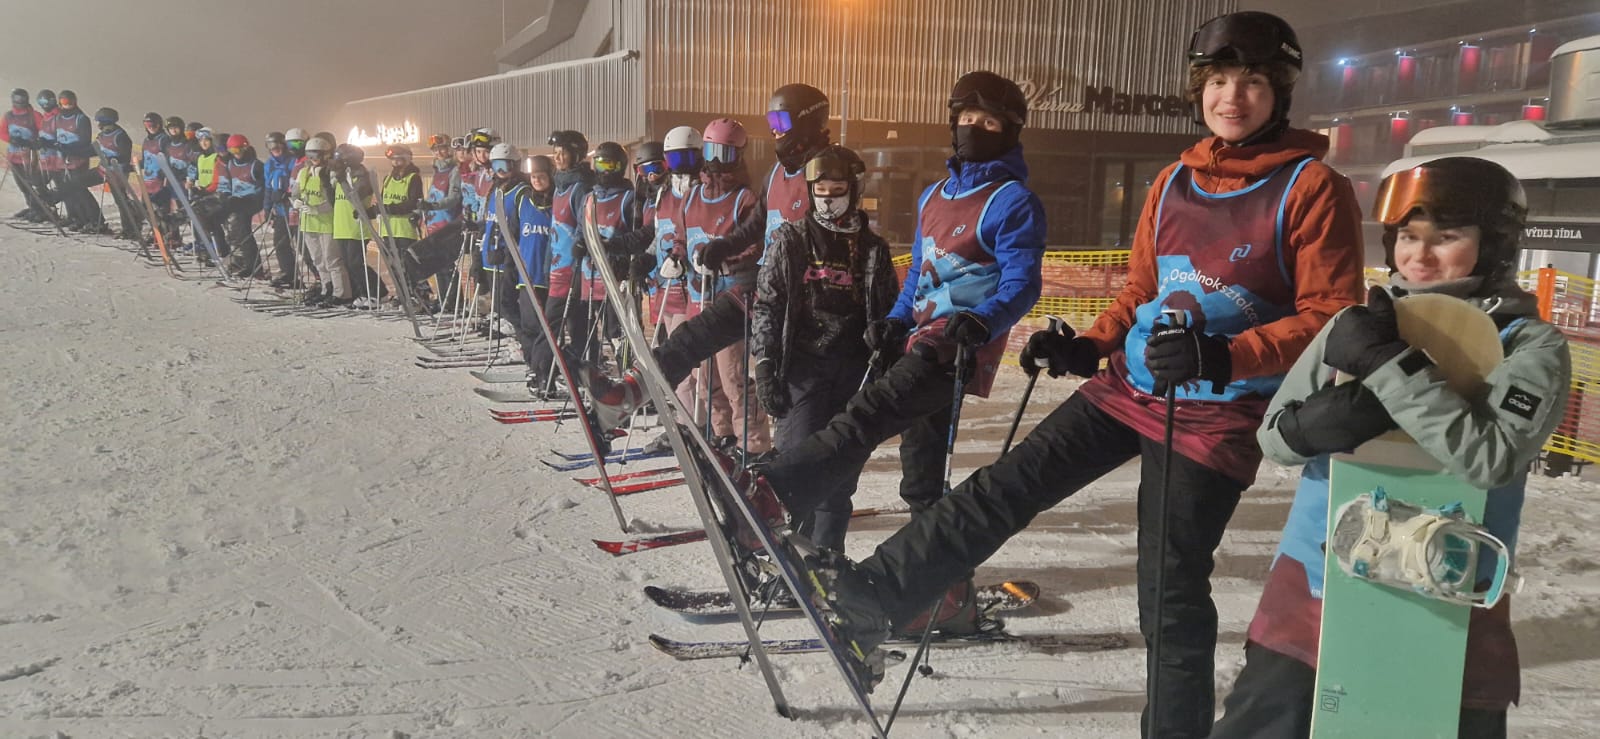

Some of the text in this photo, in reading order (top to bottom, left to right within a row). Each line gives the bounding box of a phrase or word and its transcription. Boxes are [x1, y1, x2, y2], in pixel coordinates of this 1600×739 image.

[1015, 79, 1085, 113] Pkárna
[1525, 226, 1582, 239] VÝDEJ JÍDLA
